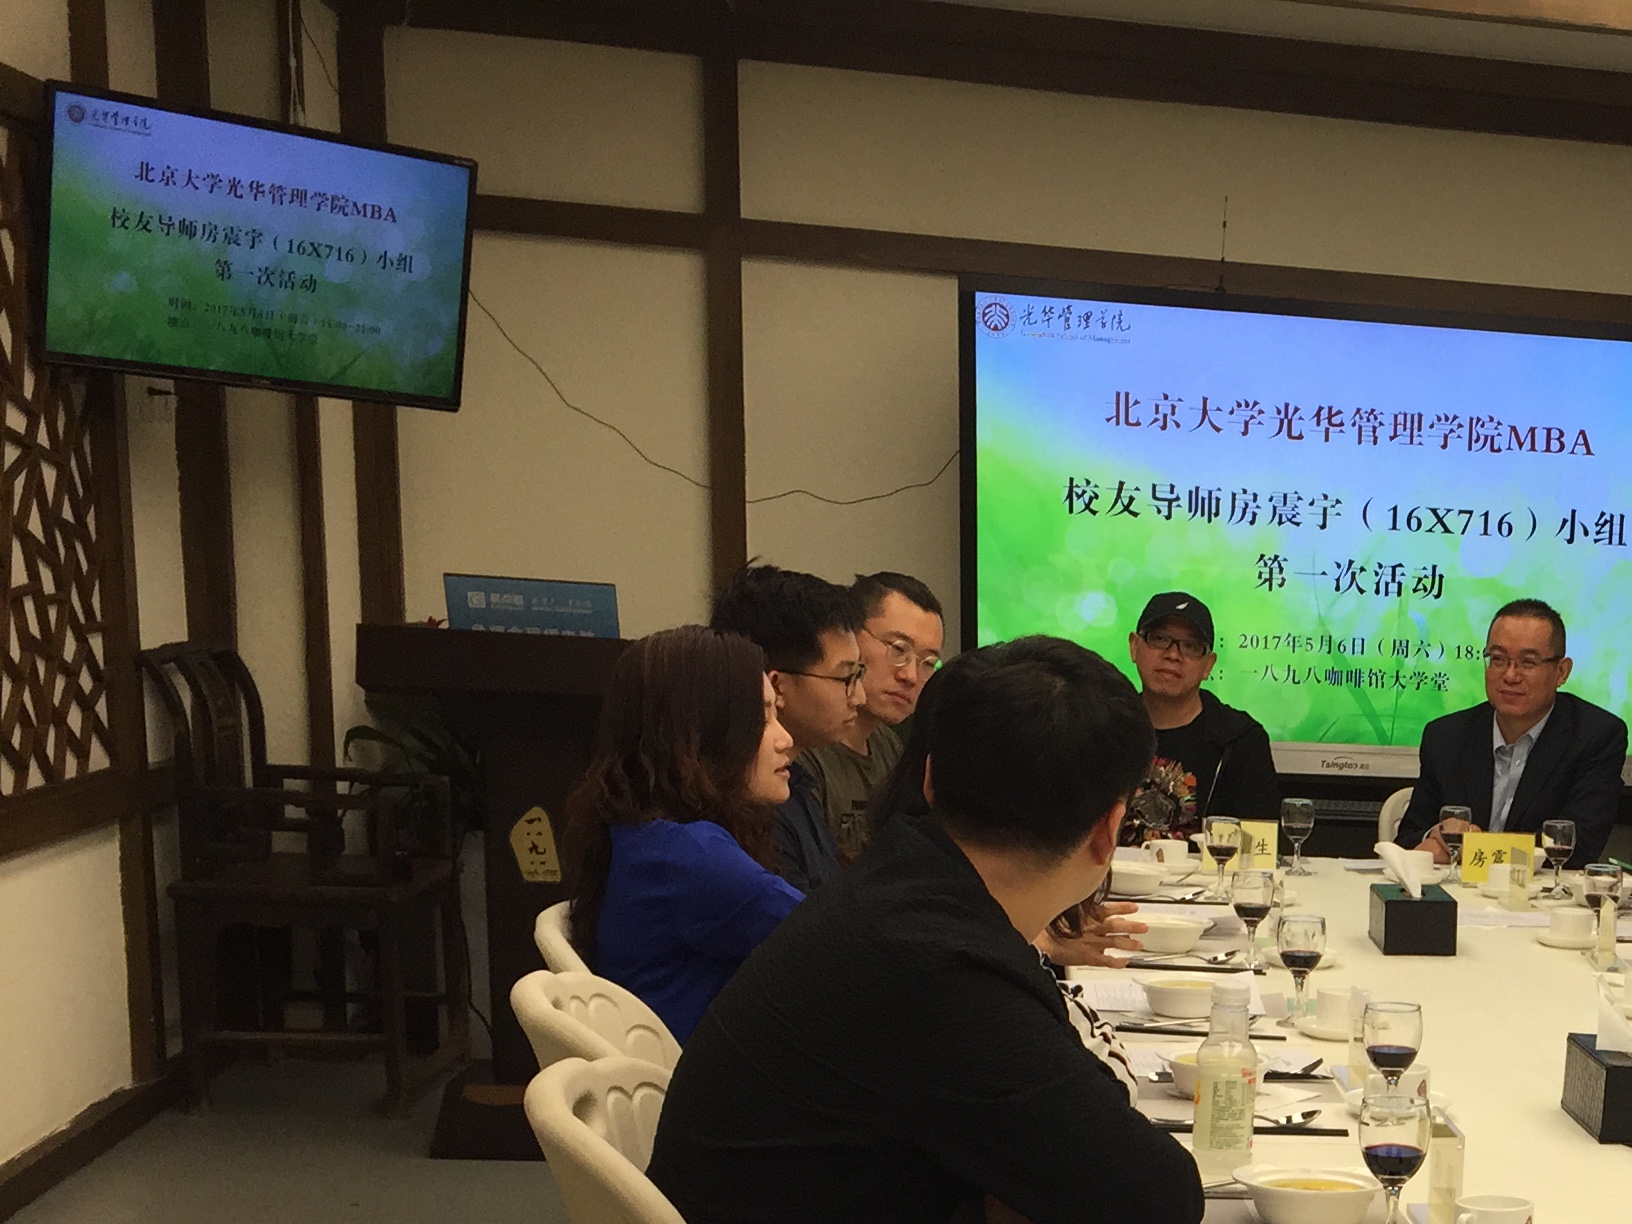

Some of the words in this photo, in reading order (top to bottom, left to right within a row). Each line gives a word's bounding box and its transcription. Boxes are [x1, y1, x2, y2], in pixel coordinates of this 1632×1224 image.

[135, 161, 398, 224] 北京大学光华管理学院MBA
[214, 259, 318, 294] 第一次活动
[1105, 391, 1595, 457] 北京大学光华管理学院MBA
[1062, 477, 1628, 548] 校友导师房震宇（16X716）小组
[1255, 554, 1445, 600] 第一次活动
